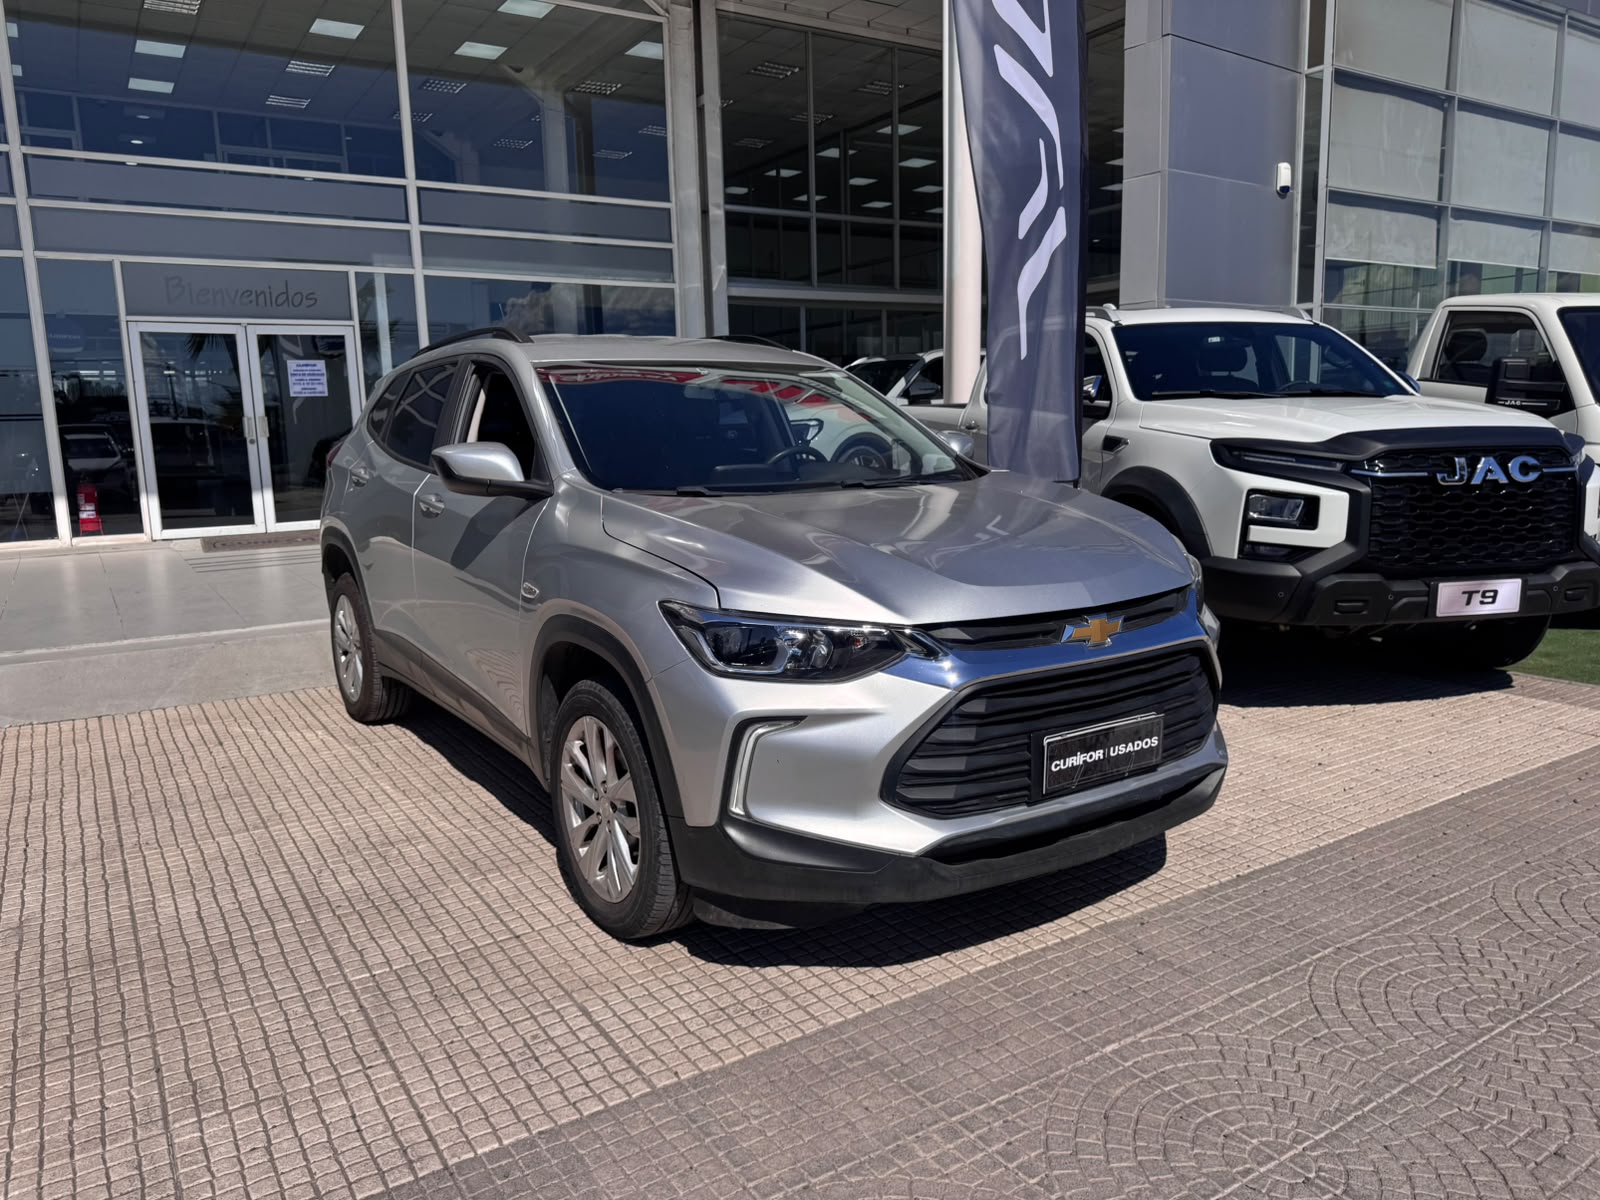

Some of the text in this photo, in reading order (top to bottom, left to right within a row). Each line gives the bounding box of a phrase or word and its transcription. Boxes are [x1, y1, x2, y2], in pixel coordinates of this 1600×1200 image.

[163, 275, 318, 308] Bienvenidos
[1436, 455, 1541, 486] JAC
[1461, 589, 1499, 607] T9
[1109, 736, 1159, 757] USADOS
